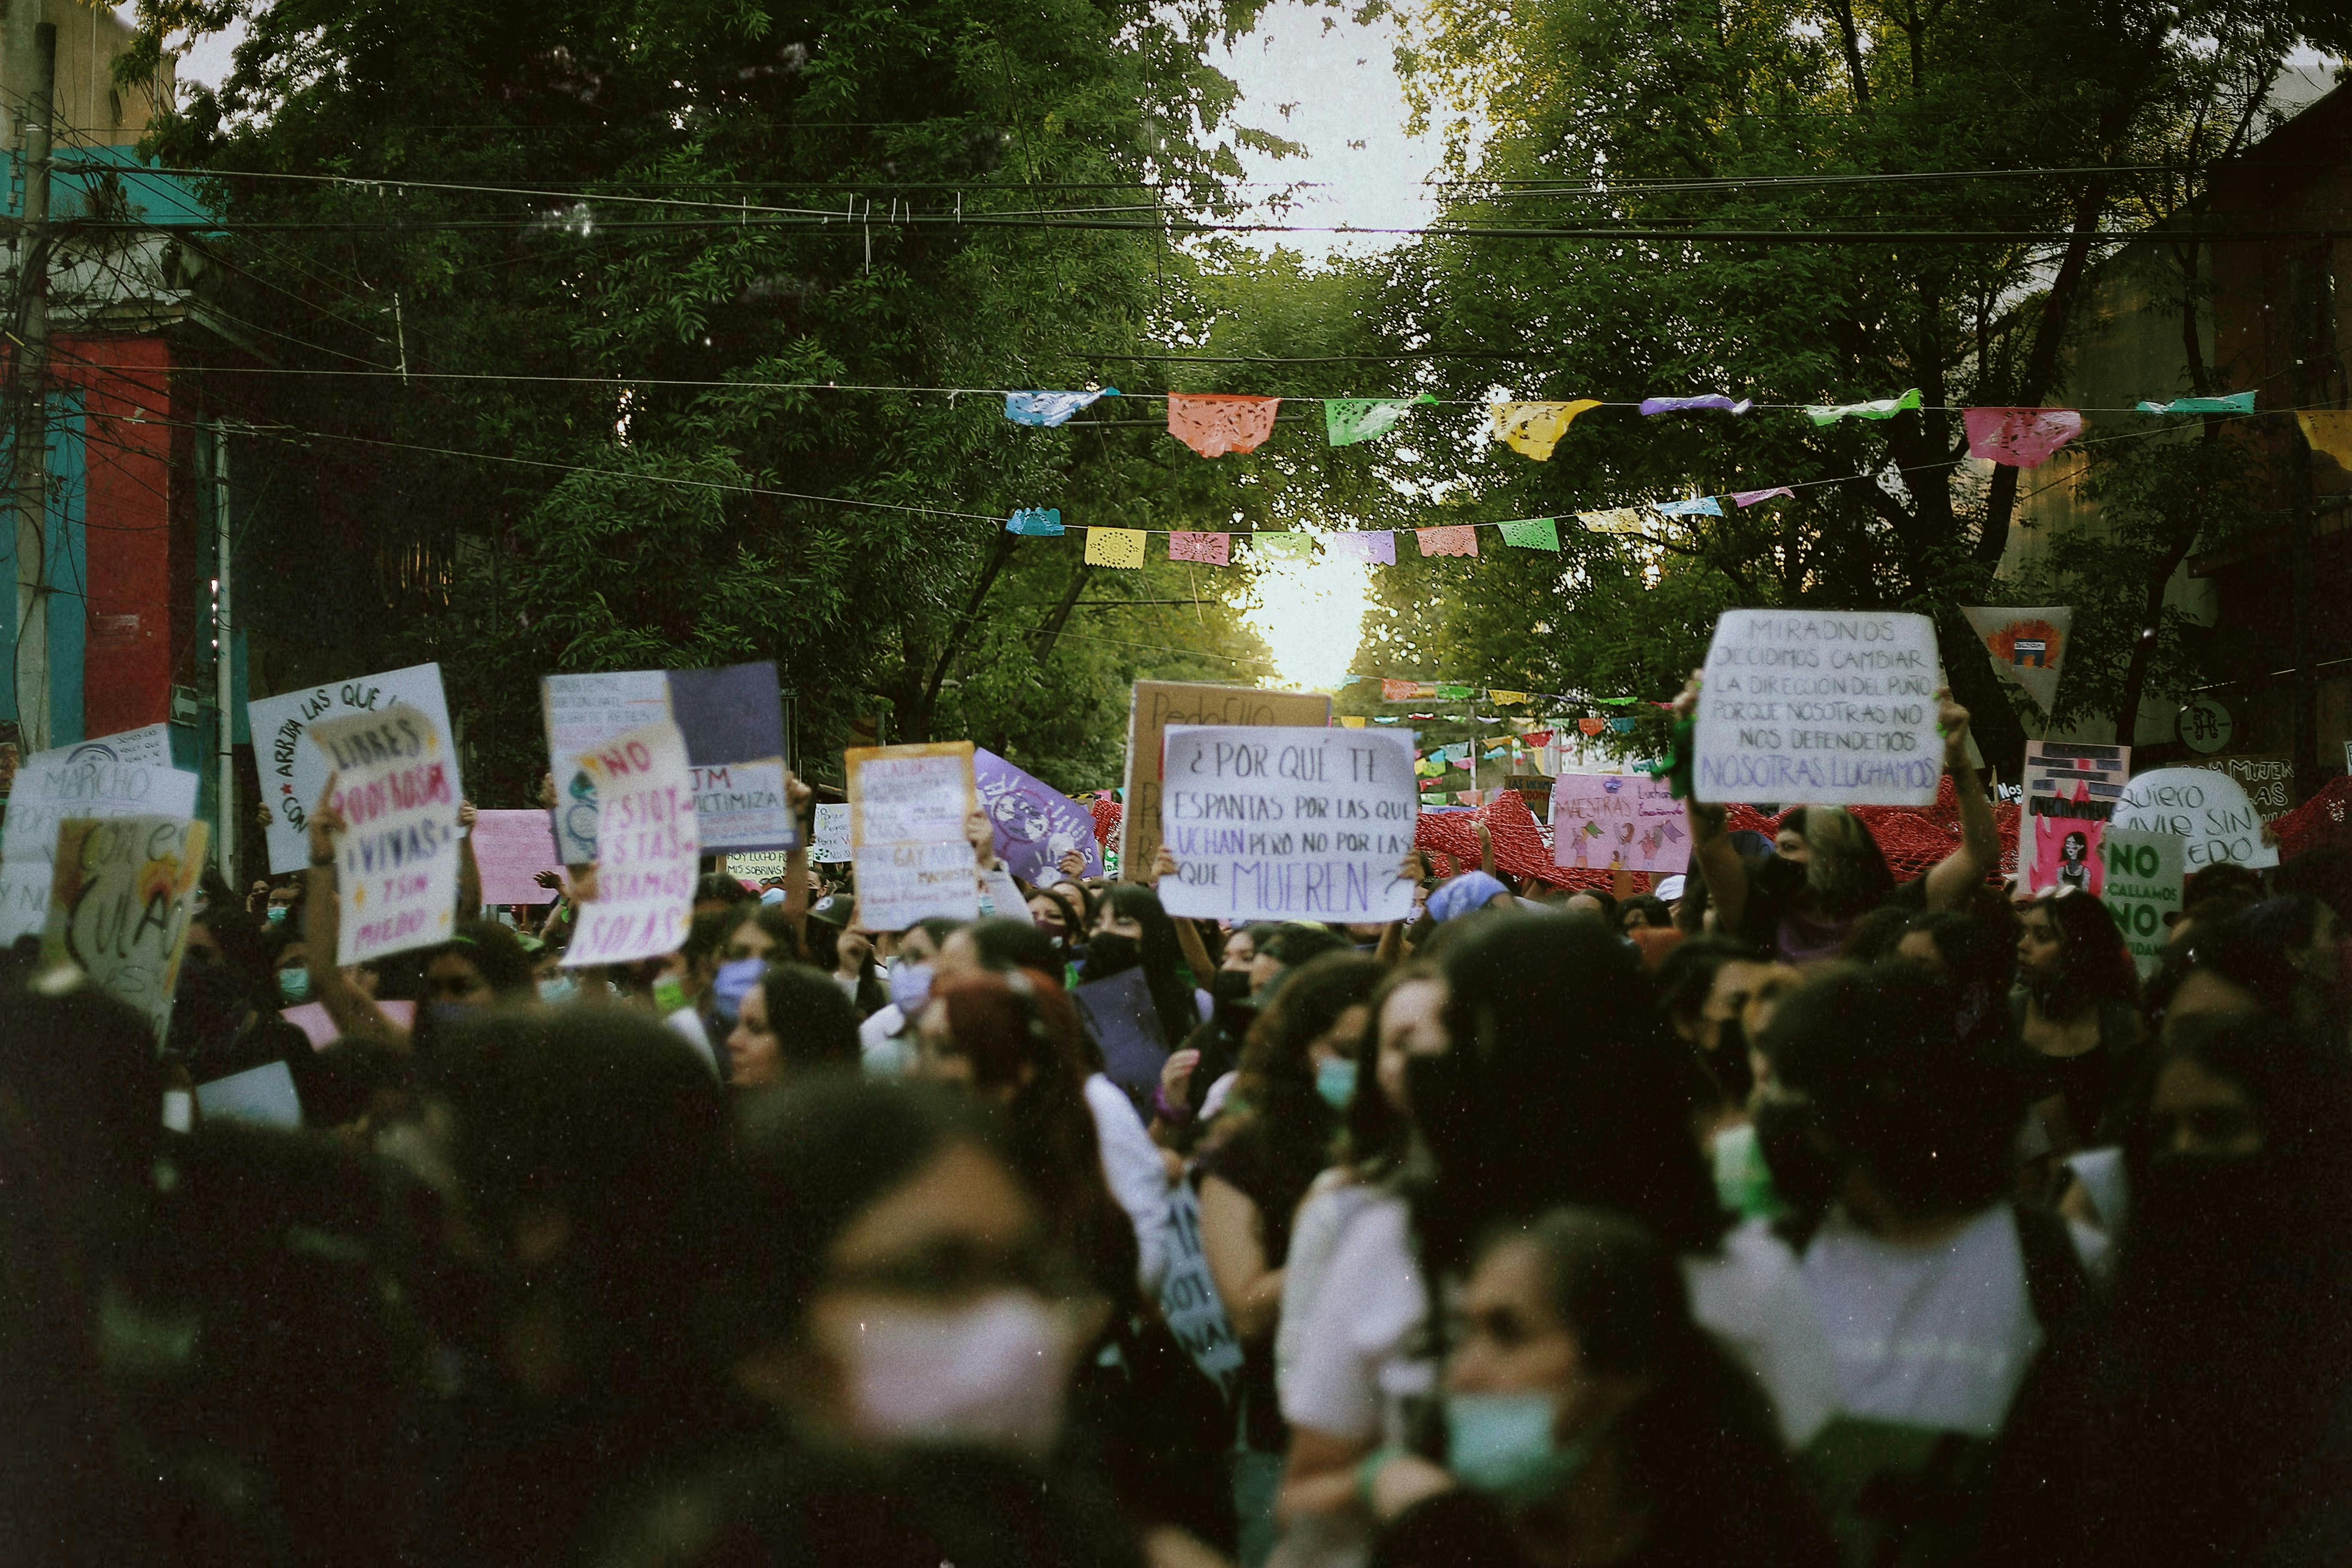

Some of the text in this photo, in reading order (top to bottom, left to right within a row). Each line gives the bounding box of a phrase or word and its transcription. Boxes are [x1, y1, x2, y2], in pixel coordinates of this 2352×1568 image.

[1747, 618, 1894, 641] MIRADNOS
[1831, 649, 1927, 669] CAMBIAR
[1715, 677, 1741, 692] LA
[1851, 676, 1883, 695] DEL
[301, 689, 331, 721] LAS
[341, 683, 380, 712] QUE
[1787, 701, 1886, 725] NOSOTRAS
[1893, 704, 1923, 725] NO
[328, 717, 422, 770] LIBRES
[1740, 728, 1917, 751] NOS DEFENDEMOS
[600, 741, 652, 776] NO
[1348, 748, 1380, 783] TE
[1702, 754, 1935, 790] NOSOTRAS LUCHAMOS
[2228, 759, 2295, 781] MUJER
[43, 763, 150, 799] MARCHO
[1176, 791, 1283, 821] ESPANTAS
[1295, 795, 1329, 818] POR
[1338, 799, 1369, 819] LAS
[1376, 801, 1412, 820] QUE
[1556, 796, 1632, 819] MAESTRAS
[2205, 806, 2252, 836] SIN
[750, 852, 776, 862] LUCHO
[1250, 833, 1293, 855] PERO
[1302, 833, 1328, 853] NO
[1336, 833, 1370, 852] POR
[1378, 834, 1411, 854] LAS
[2188, 836, 2253, 864] EDO
[746, 865, 782, 876] SOBRINAS
[2110, 842, 2159, 879] NO
[1178, 861, 1220, 886] QUE
[1232, 861, 1369, 913] MUEREN
[2108, 883, 2178, 901] CALLAMOS
[2108, 901, 2159, 937] NO
